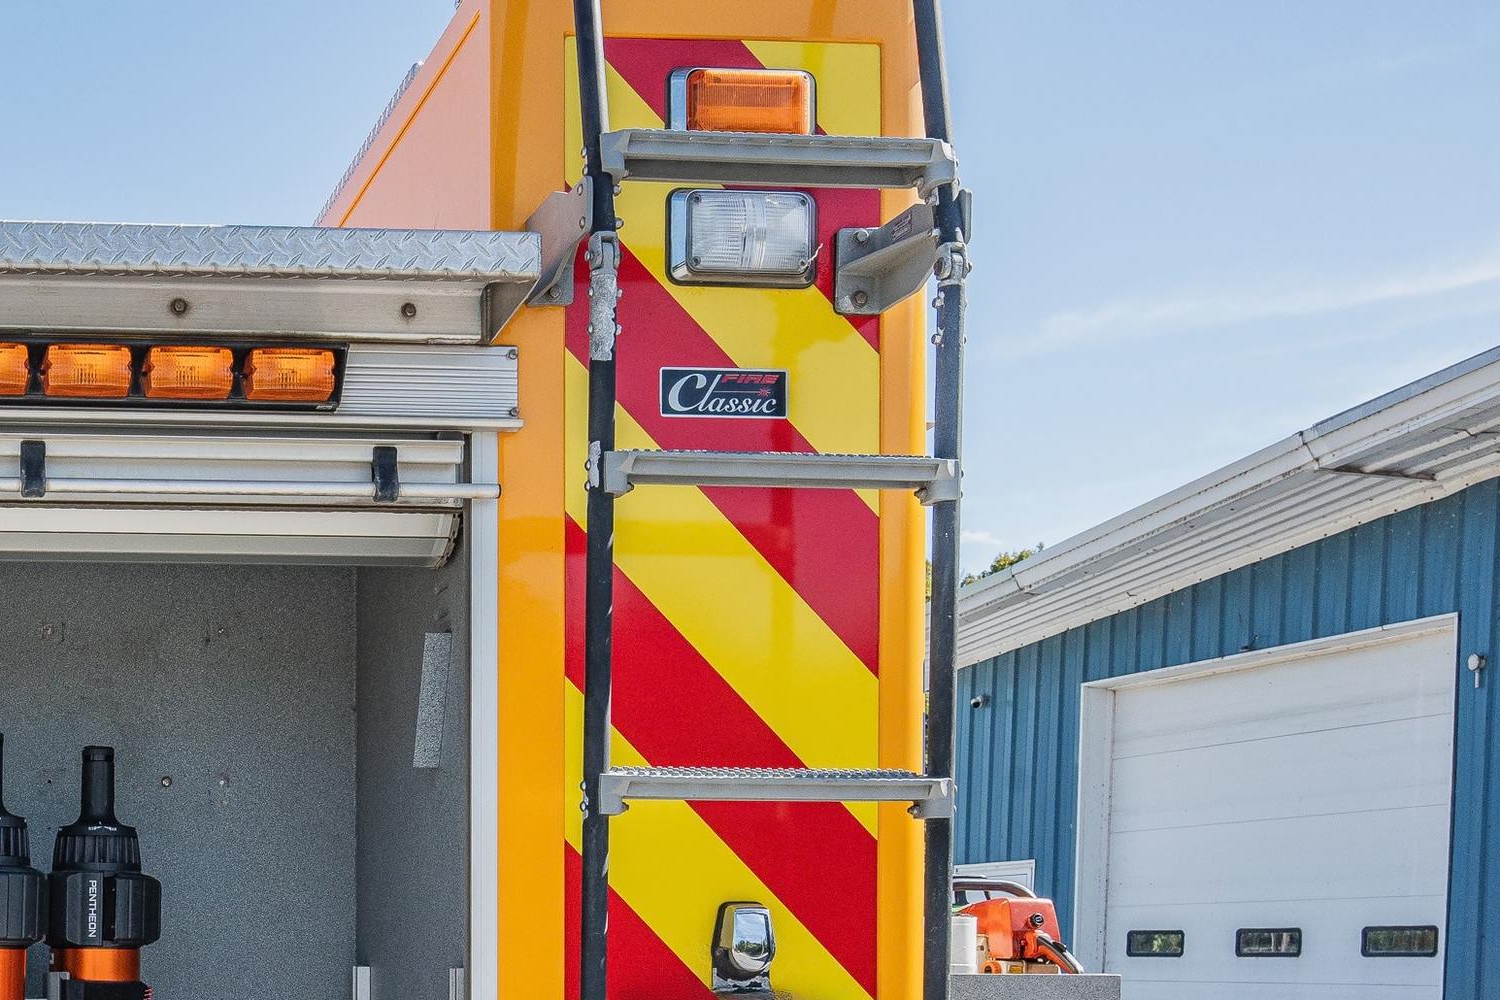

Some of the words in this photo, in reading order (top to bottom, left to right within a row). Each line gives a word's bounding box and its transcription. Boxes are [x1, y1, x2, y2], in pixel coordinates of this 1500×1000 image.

[668, 373, 777, 413] Classic
[722, 374, 779, 384] FIRE
[88, 879, 97, 938] PENTHEON
